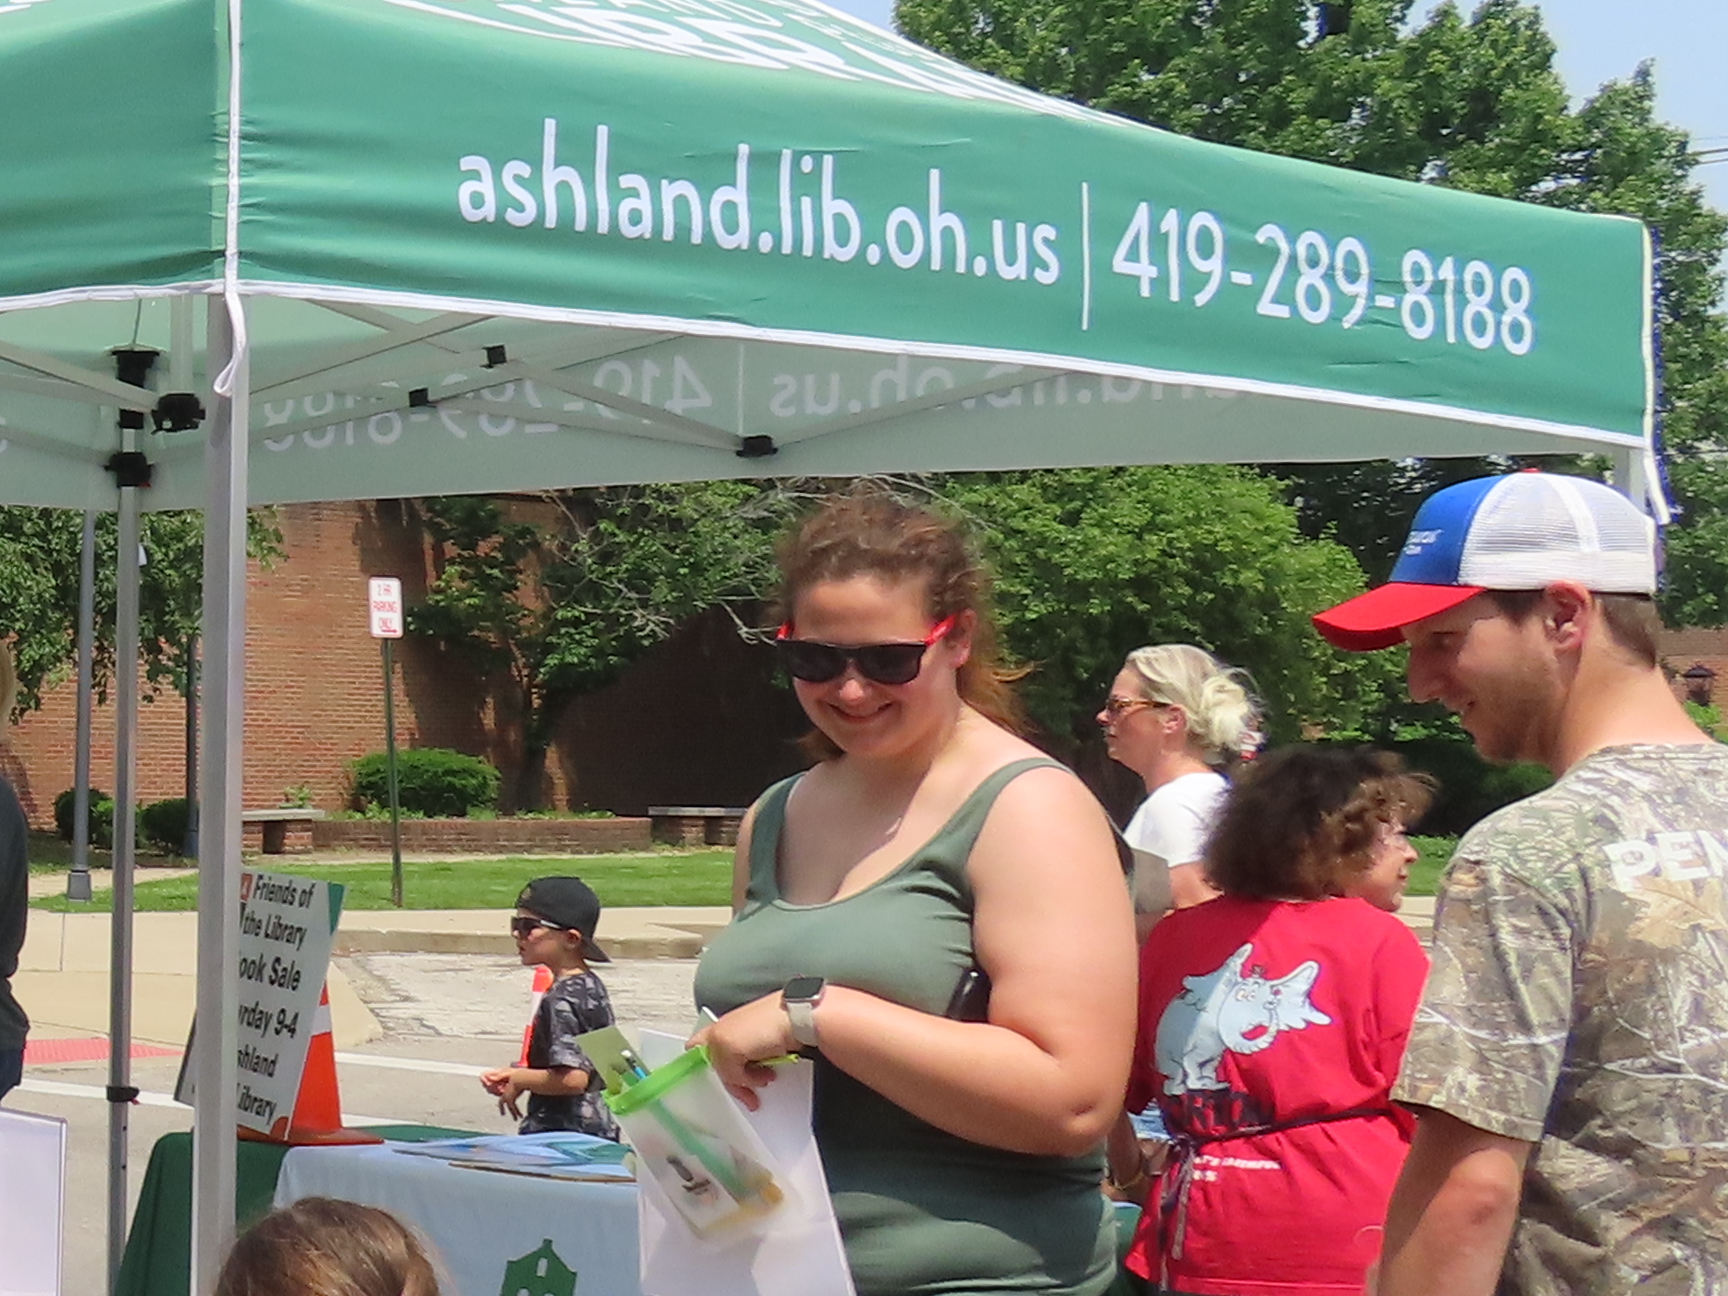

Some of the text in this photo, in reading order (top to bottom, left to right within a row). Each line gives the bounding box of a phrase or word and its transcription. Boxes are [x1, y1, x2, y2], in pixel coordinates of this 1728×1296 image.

[458, 117, 1534, 356] ashland.lib.oh.us 419-289-8188
[253, 874, 316, 910] Friends of
[243, 909, 307, 952] the Library
[239, 955, 301, 991] ook Sale
[274, 1007, 298, 1040] 9-4
[237, 1043, 278, 1079] shland
